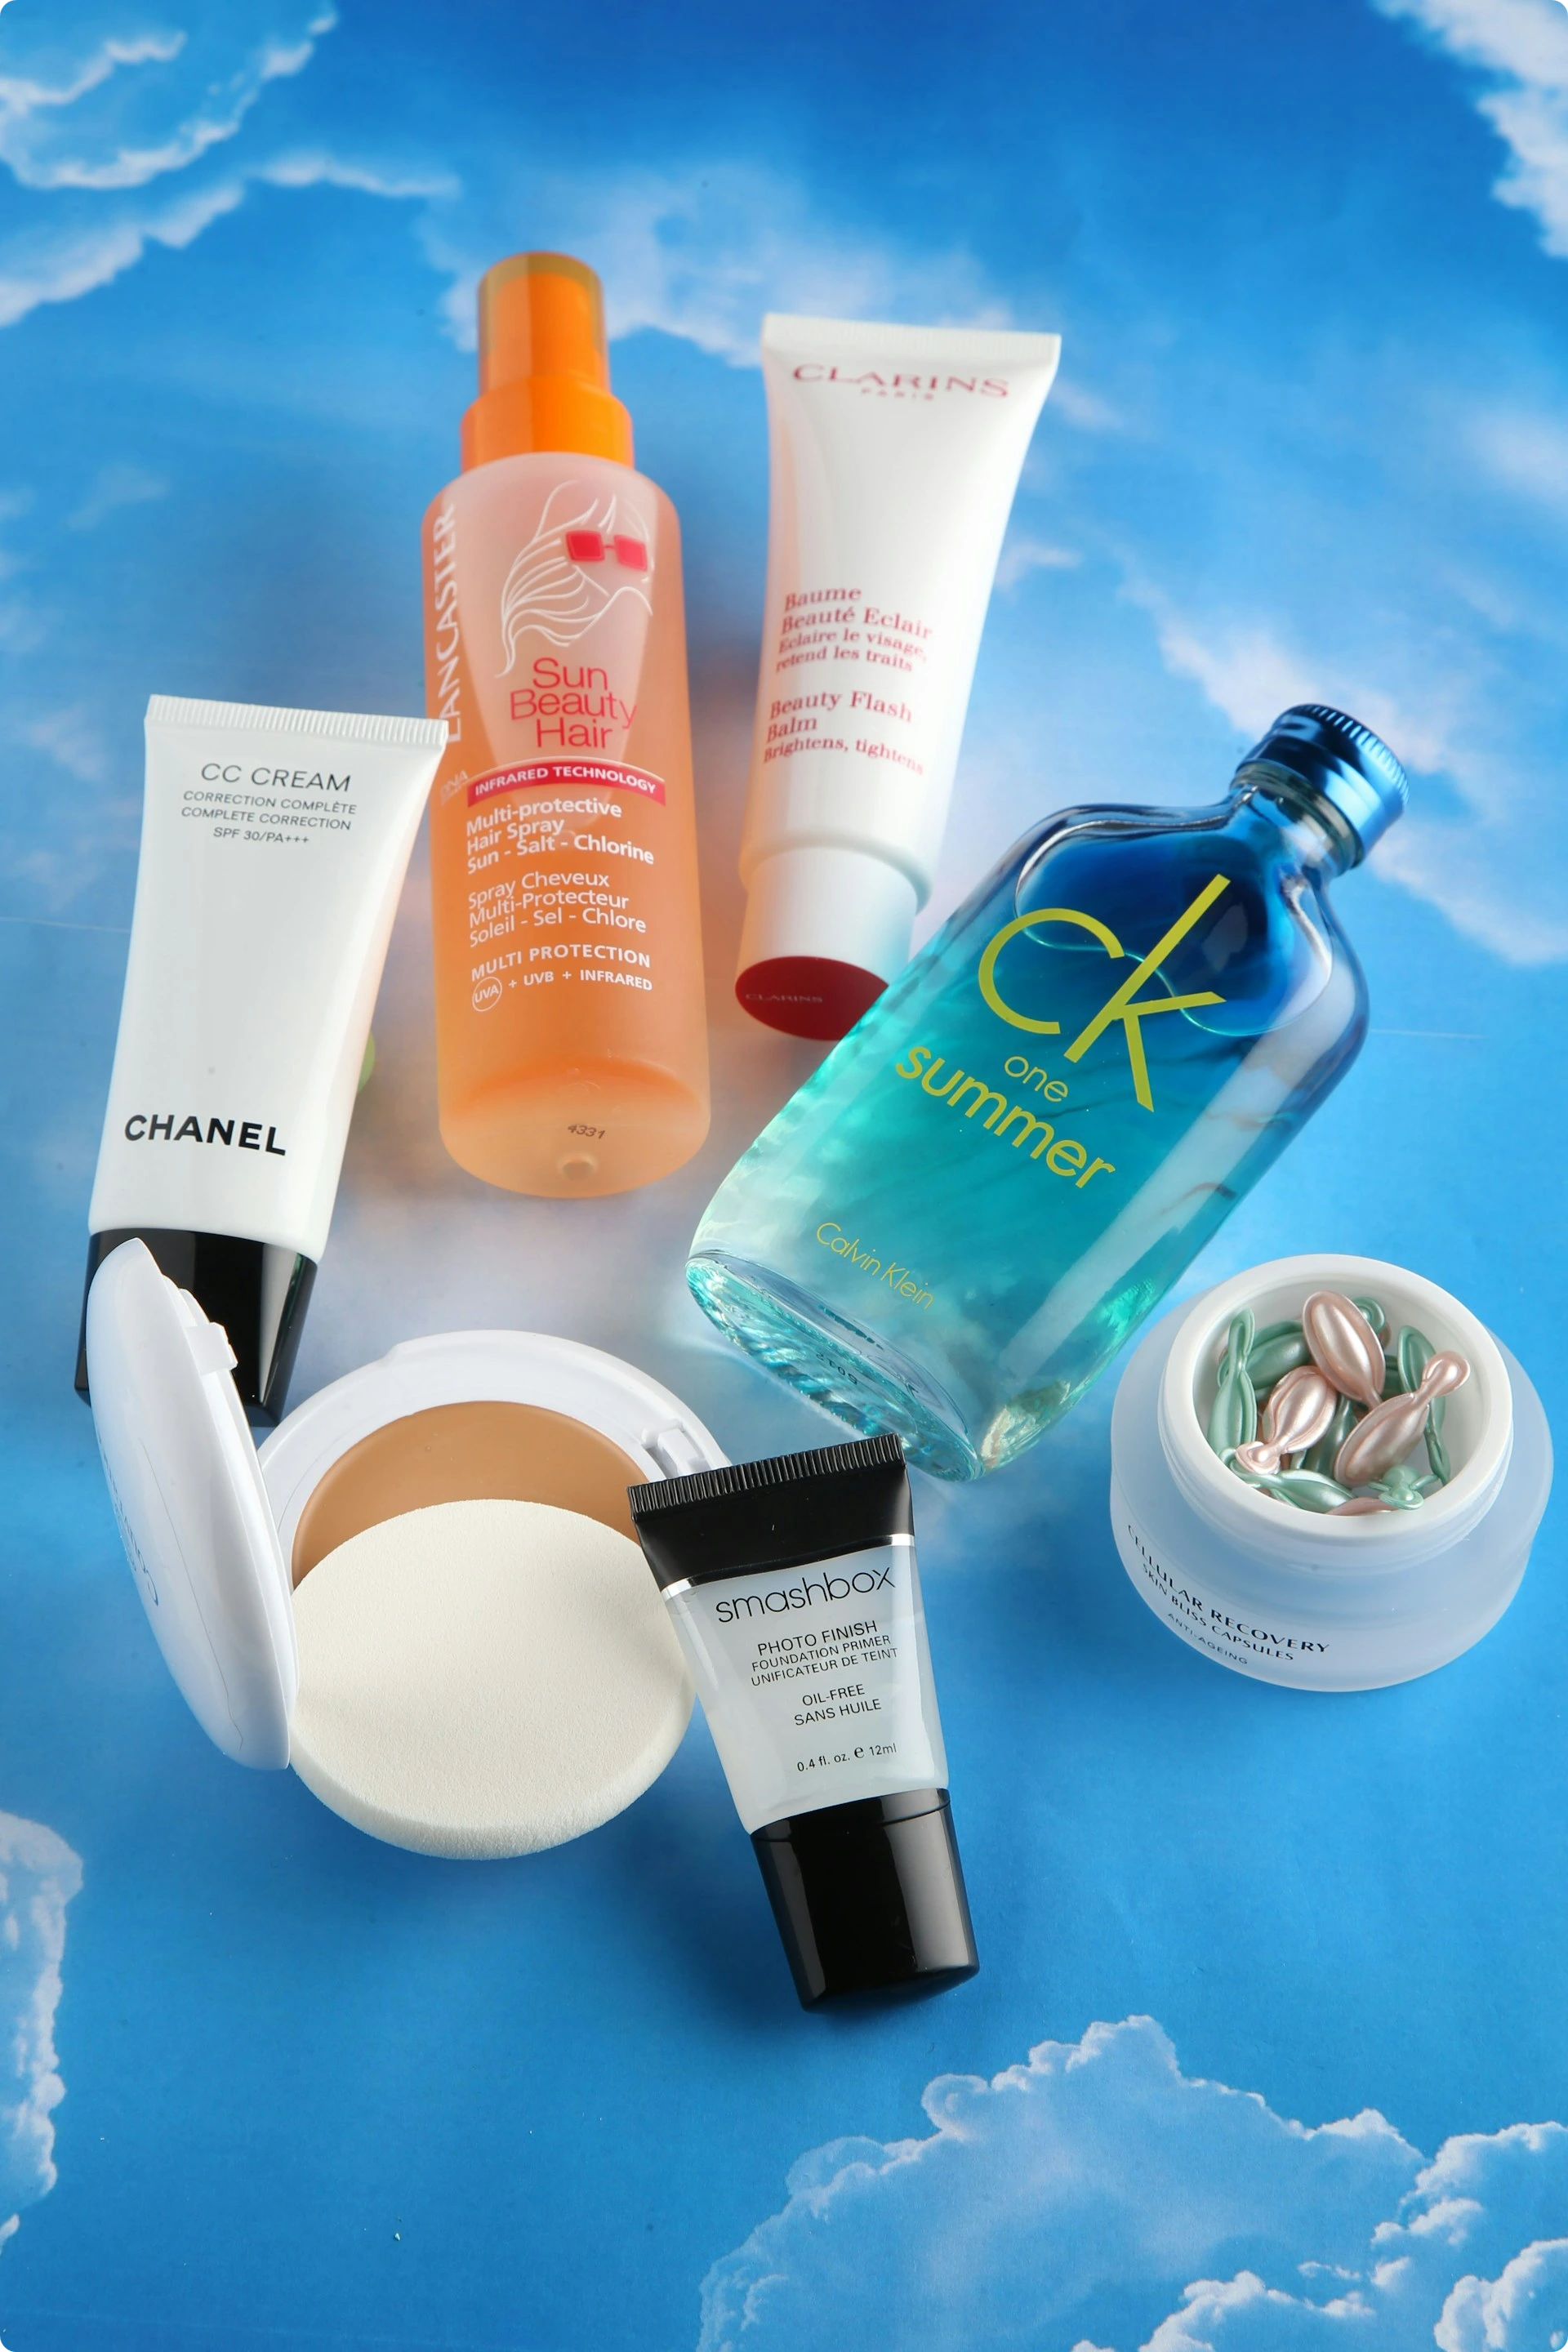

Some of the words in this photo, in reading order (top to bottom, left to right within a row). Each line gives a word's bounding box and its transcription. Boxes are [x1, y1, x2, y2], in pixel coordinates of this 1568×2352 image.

[792, 363, 1009, 399] CLARINS
[784, 586, 862, 612] Baume
[434, 503, 461, 742] LANCASTER
[778, 629, 837, 654] Eclaire
[843, 627, 860, 643] le
[781, 606, 855, 636] Beauté
[863, 607, 933, 639] Eclair
[532, 657, 608, 690] Sun
[776, 646, 827, 675] retend
[833, 645, 859, 660] les
[866, 649, 913, 672] traits
[510, 688, 636, 728] Beauty
[769, 691, 843, 721] Beauty
[850, 690, 912, 723] Flash
[537, 718, 612, 749] Hair
[765, 716, 817, 744] Balm
[764, 737, 849, 764] Brightens,
[855, 738, 923, 775] tightens
[201, 763, 243, 783] CC
[251, 767, 351, 792] CREAM
[475, 768, 549, 795] INFRARED
[553, 766, 656, 795] TECHNOLOGY
[181, 807, 255, 822] COMPLETE
[259, 813, 351, 831] CORRECTION
[183, 791, 277, 808] CORRECTION
[280, 798, 358, 815] COMPLÈTE
[466, 798, 621, 836] Multi-protective
[213, 826, 241, 839] SPF
[243, 831, 310, 844] 30/PA+++
[467, 831, 501, 856] Hair
[507, 819, 564, 840] Spray
[468, 850, 499, 875] Sun
[517, 835, 555, 856] Salt
[574, 835, 654, 865] Chlorine
[468, 880, 515, 910] Spray
[522, 871, 609, 890] Cheveux
[470, 889, 629, 929] Multi-Protecteur
[470, 918, 514, 947] Soleil
[533, 907, 563, 927] Sel
[582, 907, 647, 933] Chlore
[471, 951, 522, 982] MULTI
[530, 944, 651, 969] PROTECTION
[474, 985, 499, 1004] UVA
[523, 971, 555, 987] UVB
[580, 969, 653, 991] INFRARED
[746, 993, 823, 1003] CLARINS
[1004, 1056, 1069, 1102] one
[124, 1114, 286, 1156] CHANEL
[568, 1125, 605, 1139] 4331
[895, 1045, 1116, 1189] summer
[817, 1223, 881, 1276] Calvin
[880, 1262, 934, 1310] Klein
[715, 1567, 896, 1623] smashbox
[1128, 1525, 1203, 1611] CELLULAR
[1210, 1609, 1330, 1653] RECOVERY
[1143, 1563, 1168, 1596] SKIN
[1171, 1595, 1206, 1626] BLISS
[1212, 1625, 1294, 1660] CAPSULES
[751, 1645, 840, 1672] FOUNDATION
[842, 1634, 891, 1652] PRIMER
[757, 1633, 817, 1656] PHOTO
[822, 1619, 878, 1644] FINISH
[1168, 1612, 1248, 1664] ANTI-AGEING
[751, 1659, 839, 1686] UNIFICATEUR
[842, 1655, 859, 1667] DE
[863, 1647, 898, 1663] TEINT
[794, 1707, 835, 1726] SANS
[839, 1699, 882, 1717] HUILE
[802, 1683, 866, 1706] OIL-FREE
[797, 1759, 816, 1772] 0.4
[818, 1755, 831, 1766] fl.
[834, 1753, 850, 1763] oz.
[869, 1743, 897, 1757] 12ml
